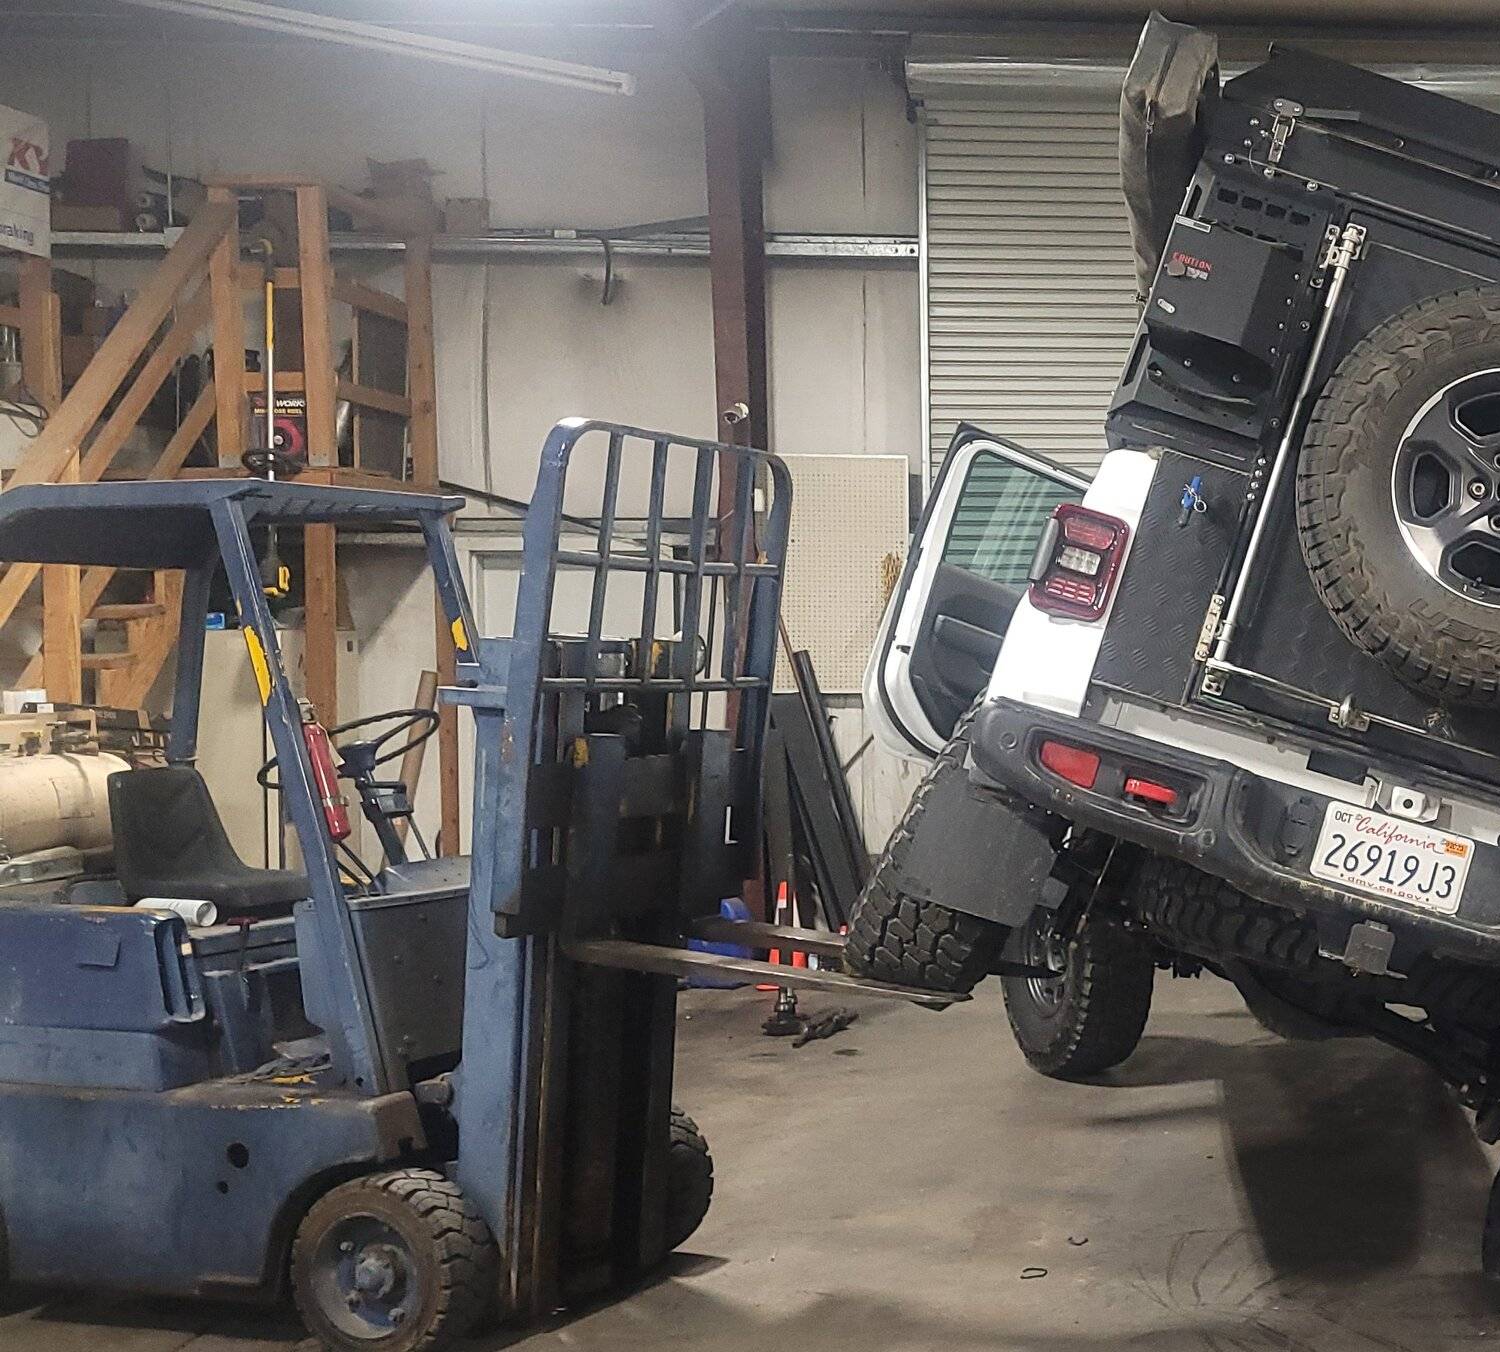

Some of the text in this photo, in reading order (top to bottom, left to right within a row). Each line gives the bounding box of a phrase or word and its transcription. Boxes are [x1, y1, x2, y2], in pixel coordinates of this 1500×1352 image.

[1335, 810, 1444, 855] OCT California
[1324, 833, 1456, 899] 26919J3
[1347, 875, 1424, 902] dmv.ca.gov
